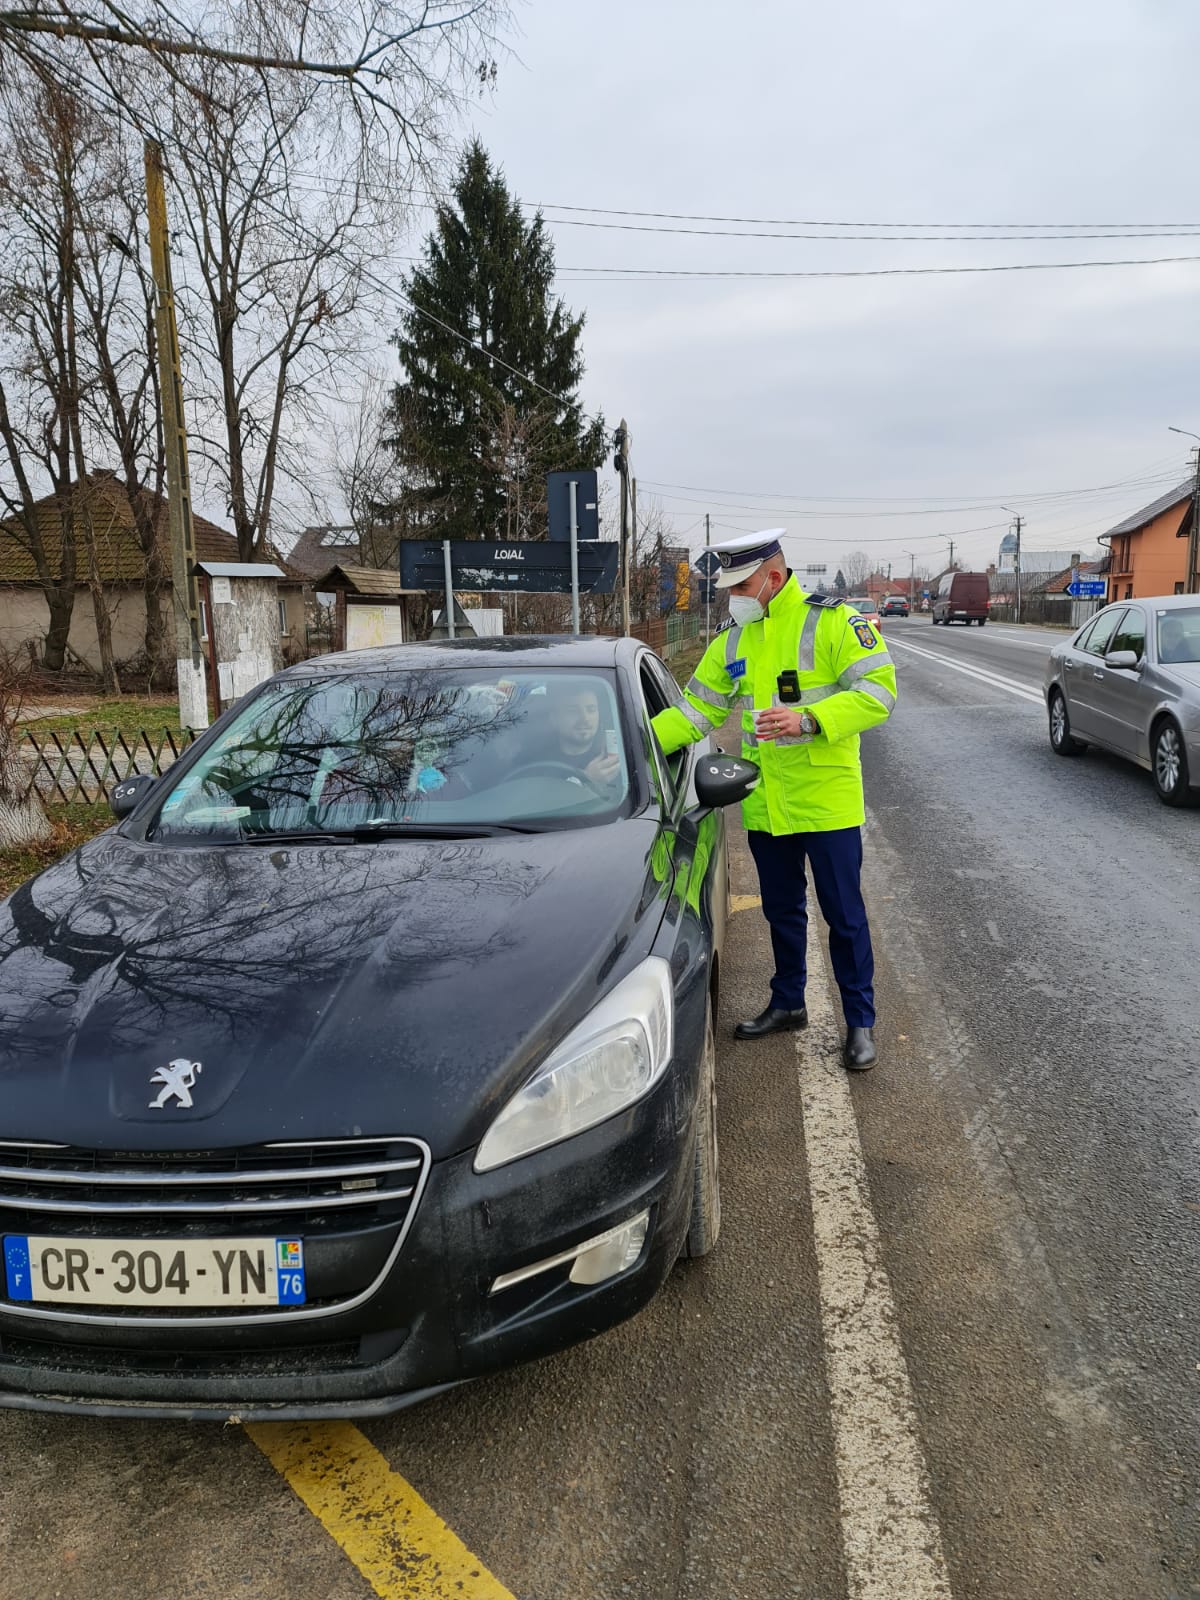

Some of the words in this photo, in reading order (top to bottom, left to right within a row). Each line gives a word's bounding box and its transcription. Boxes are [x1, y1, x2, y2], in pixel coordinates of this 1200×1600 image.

[494, 549, 525, 560] LOIAL
[114, 1151, 215, 1159] PEUGEOT
[41, 1247, 267, 1295] CR-304-YN
[15, 1273, 23, 1287] F
[281, 1274, 302, 1295] 76
